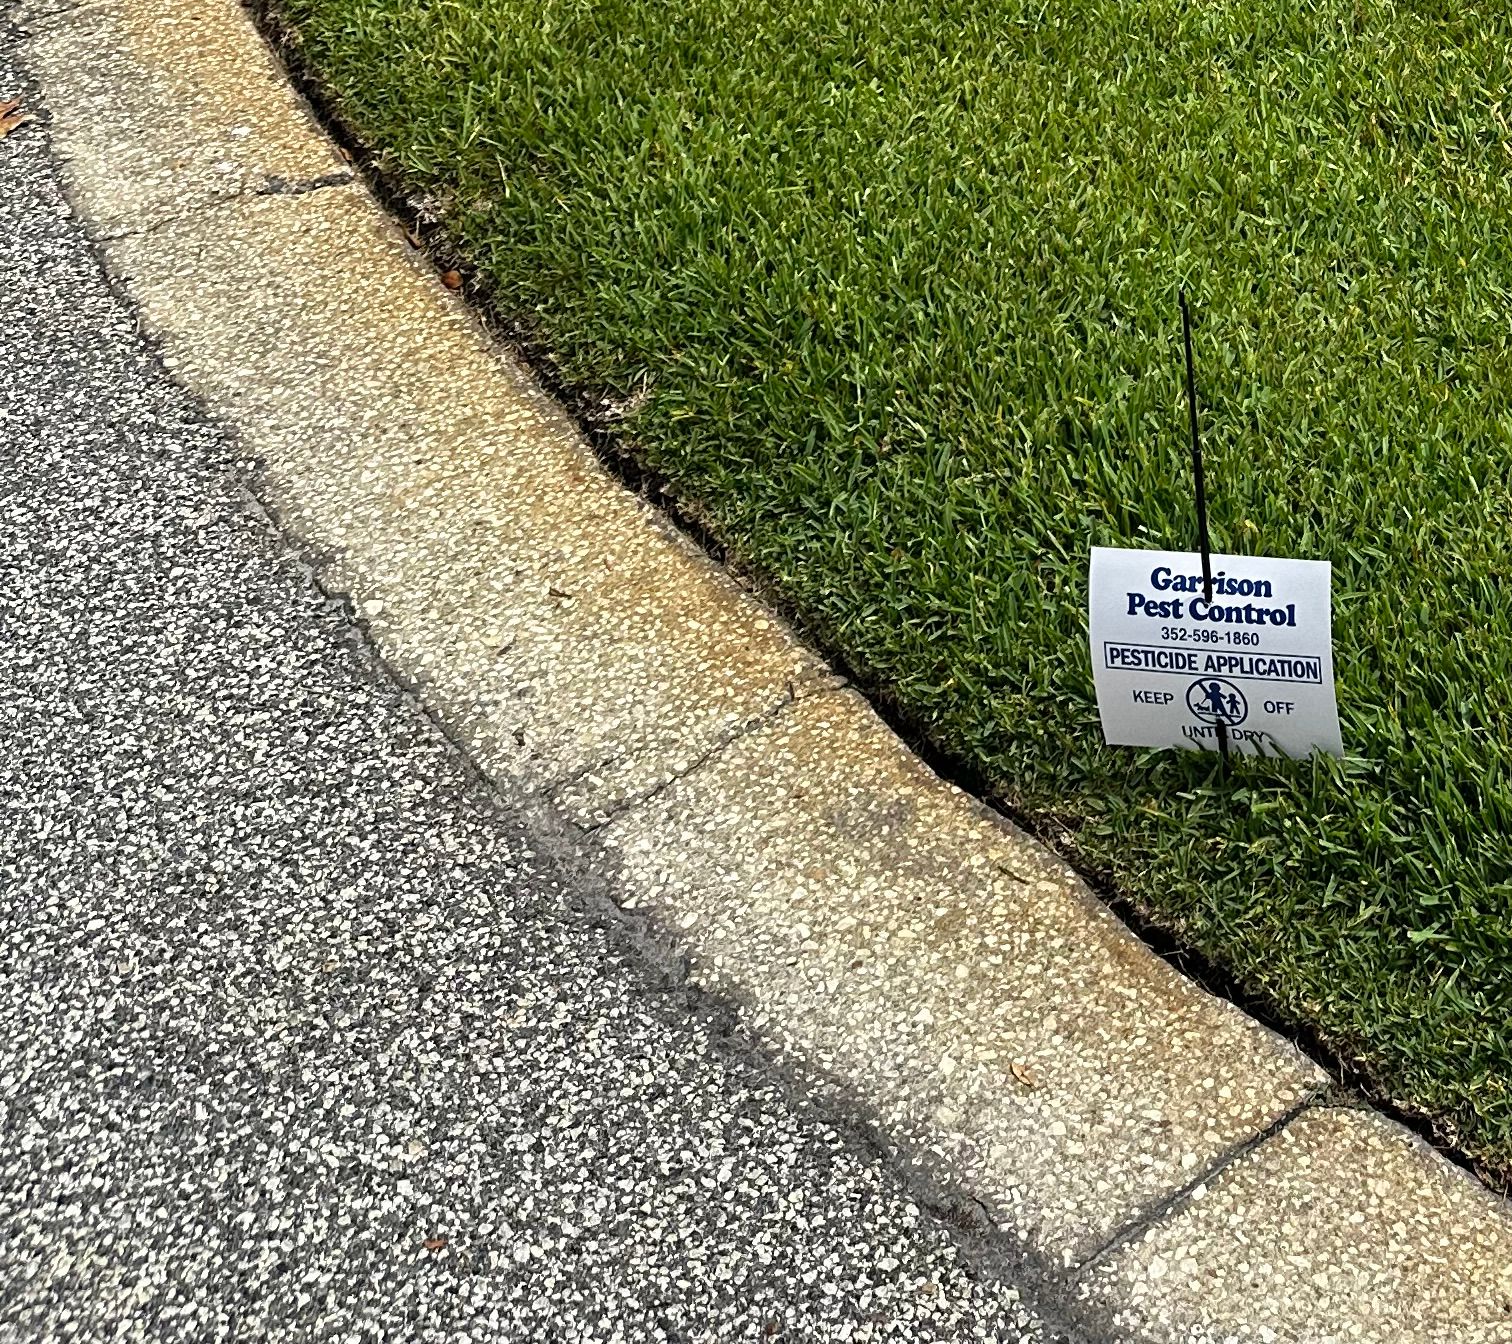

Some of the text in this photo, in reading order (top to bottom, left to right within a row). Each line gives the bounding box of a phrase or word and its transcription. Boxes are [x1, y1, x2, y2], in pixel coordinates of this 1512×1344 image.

[1150, 566, 1273, 598] Garison
[1126, 593, 1297, 627] Pest Control
[1161, 627, 1260, 646] 352-596-1860
[1109, 647, 1318, 680] PESTICIDE APPLICATION
[1132, 690, 1295, 715] KEEP OFF
[1231, 728, 1265, 743] DRY
